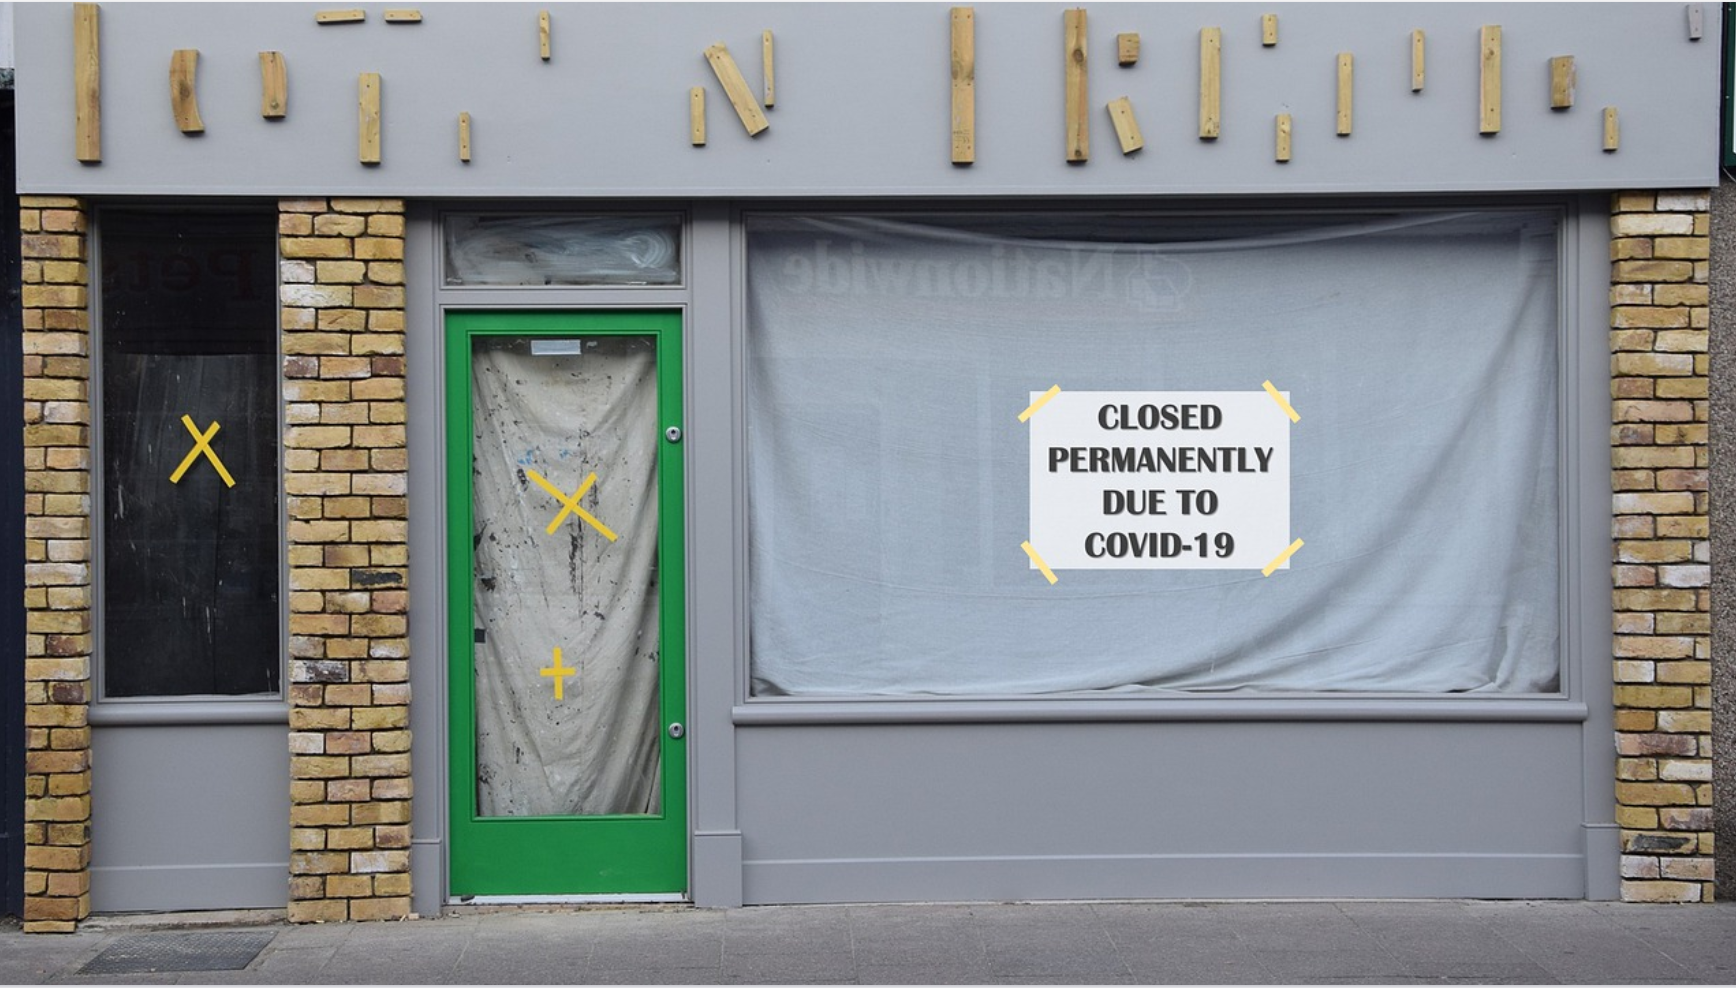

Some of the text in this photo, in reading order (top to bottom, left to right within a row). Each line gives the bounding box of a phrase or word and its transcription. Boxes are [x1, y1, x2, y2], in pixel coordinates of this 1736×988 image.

[1098, 404, 1223, 430] CLOSED
[1049, 447, 1273, 473] PERMANENTLY
[1103, 489, 1219, 515] DUE TO
[1084, 532, 1235, 558] COVID-19
